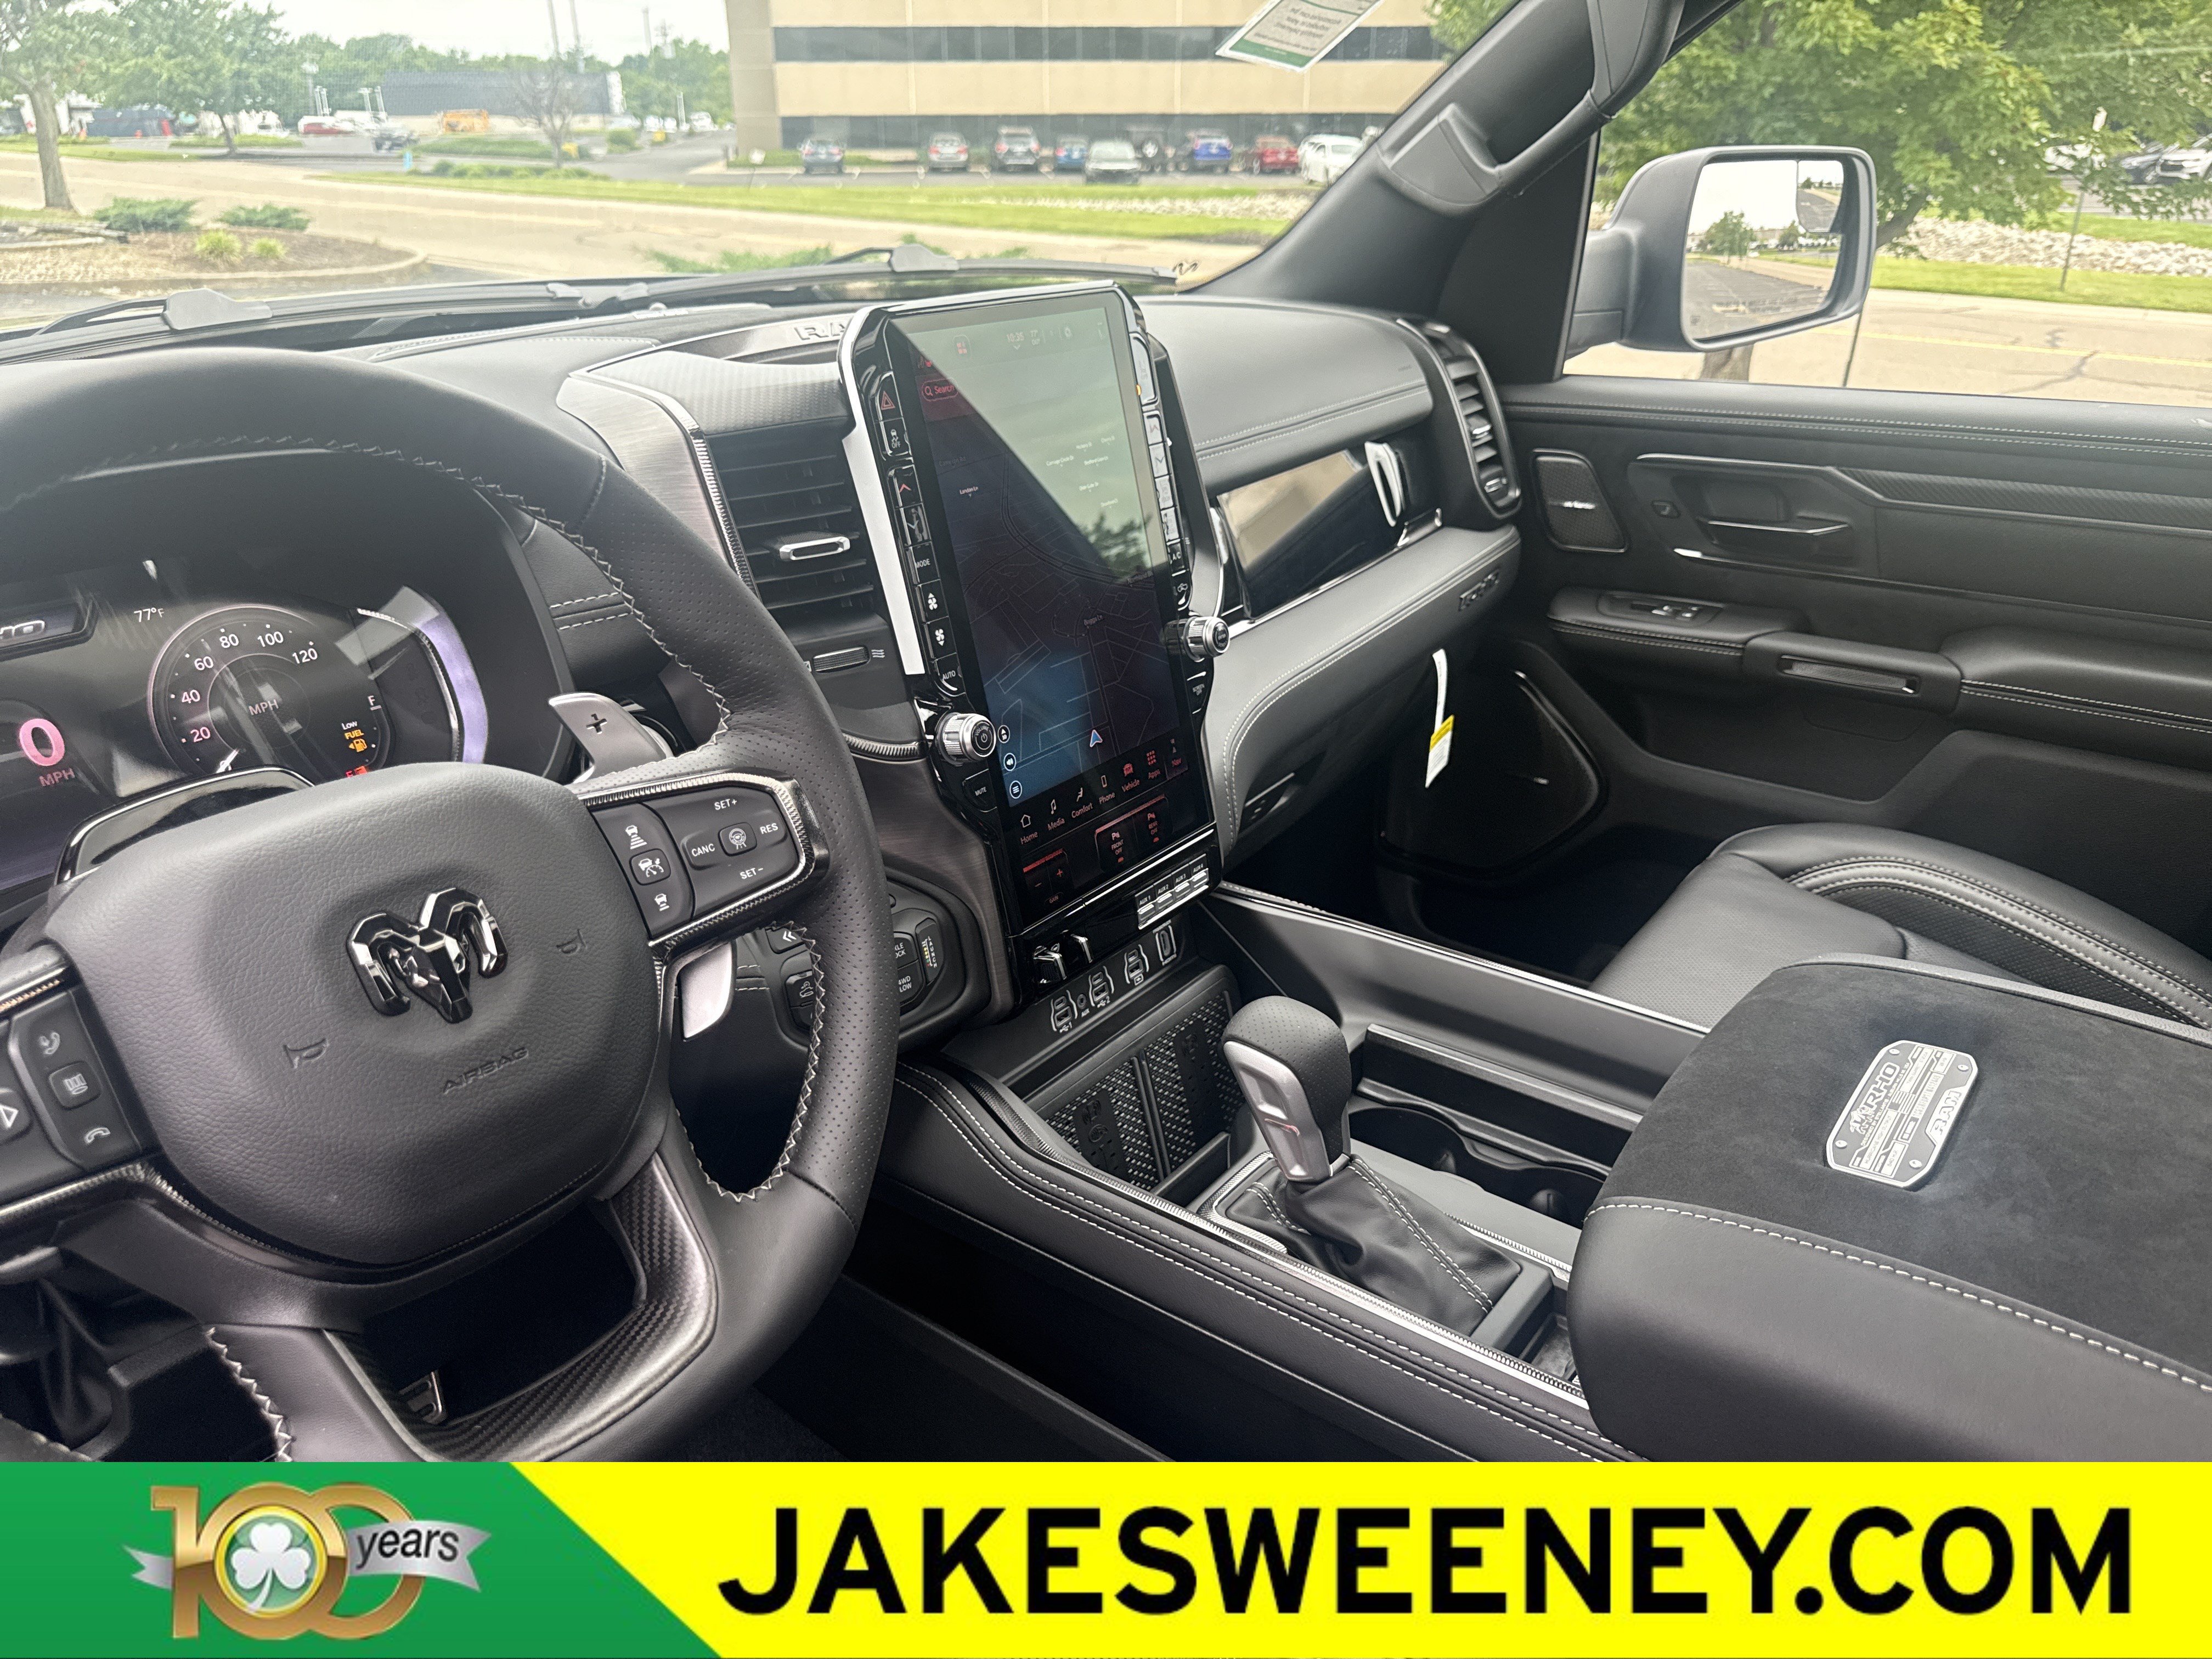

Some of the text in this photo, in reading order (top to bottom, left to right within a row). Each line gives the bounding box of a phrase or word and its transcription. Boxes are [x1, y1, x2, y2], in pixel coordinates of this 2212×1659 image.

[794, 323, 845, 340] RA
[934, 384, 955, 394] Search
[891, 441, 901, 449] OFF
[916, 558, 930, 569] MODE
[219, 634, 239, 648] 80
[257, 631, 284, 647] 100
[292, 647, 318, 664] 120
[194, 656, 214, 671] 60
[943, 670, 956, 681] AUTO
[181, 689, 201, 704] 40
[368, 695, 376, 707] F
[248, 698, 279, 716] MPH
[190, 726, 211, 743] 20
[345, 729, 364, 740] FUEL
[20, 718, 65, 766] 0
[38, 768, 75, 787] MPH
[1148, 769, 1160, 780] Apps
[975, 786, 987, 797] MUTE
[1121, 778, 1141, 793] Vehicle
[714, 798, 737, 811] SET+
[1099, 792, 1115, 805] Phone
[1071, 802, 1094, 819] Comfort
[760, 822, 778, 834] RES
[1047, 817, 1065, 832] Media
[1020, 831, 1038, 845] Home
[1111, 839, 1124, 850] FRONT
[691, 843, 715, 857] CANC
[898, 975, 911, 985] 4WD
[899, 982, 912, 992] LOW
[442, 1046, 530, 1094] AIRBAG
[1863, 1062, 1900, 1108] RHO
[1931, 1091, 1962, 1136] RAM
